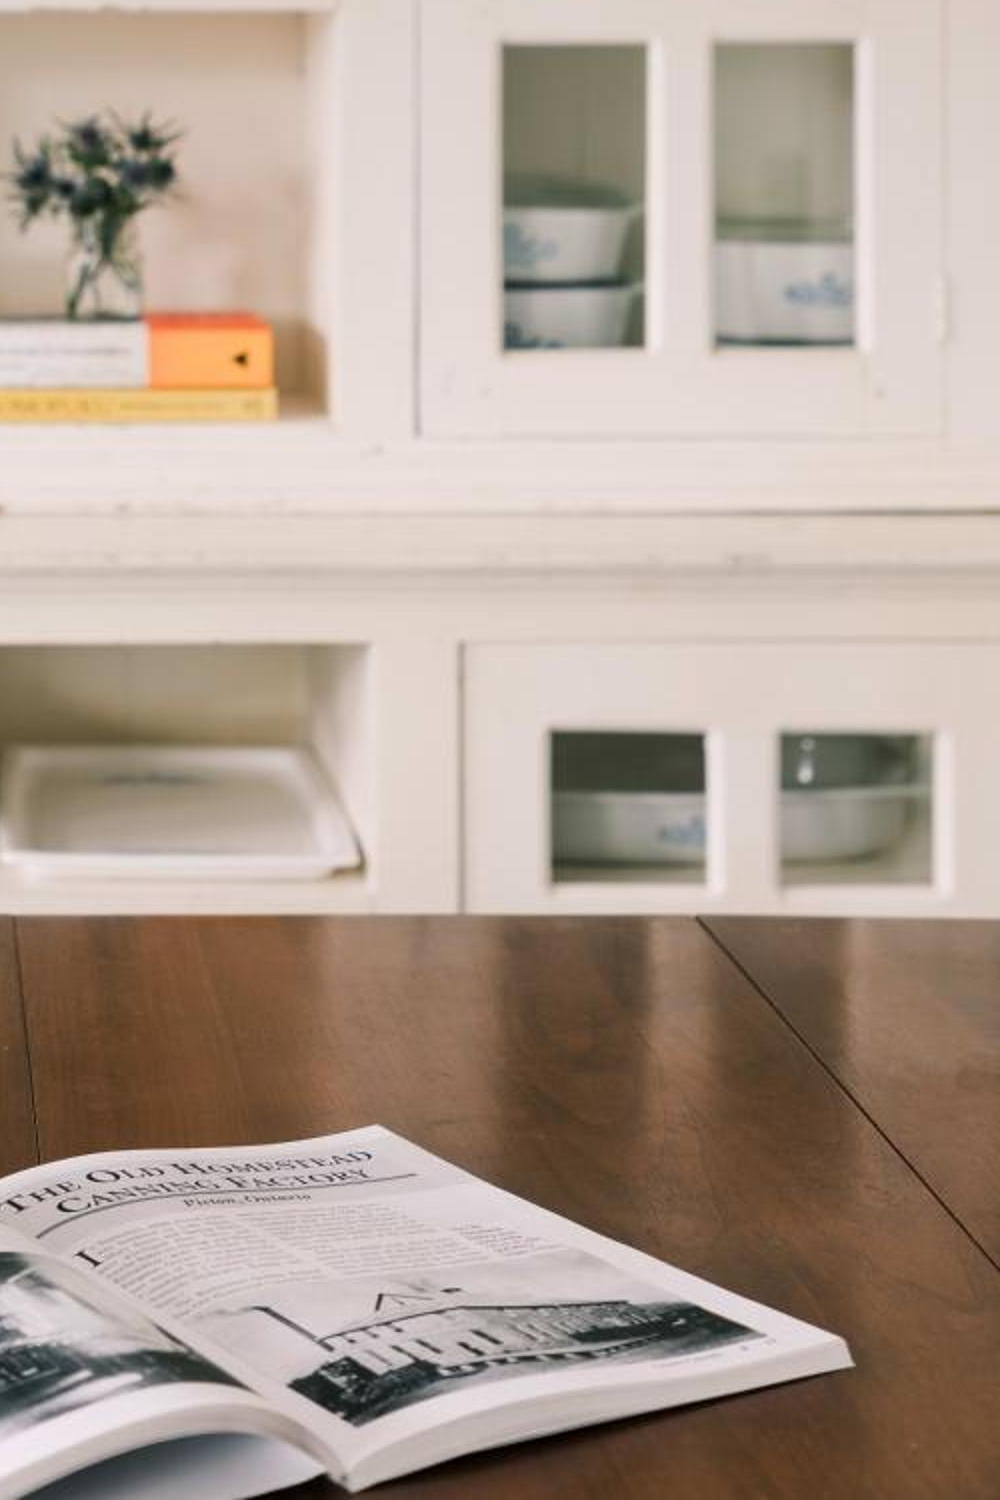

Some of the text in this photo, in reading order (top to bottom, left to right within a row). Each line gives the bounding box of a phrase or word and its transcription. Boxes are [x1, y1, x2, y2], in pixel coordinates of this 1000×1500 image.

[86, 1166, 165, 1184] OLD
[171, 1151, 373, 1175] HOMESTEAD
[56, 1168, 369, 1213] CANNING FACTORY
